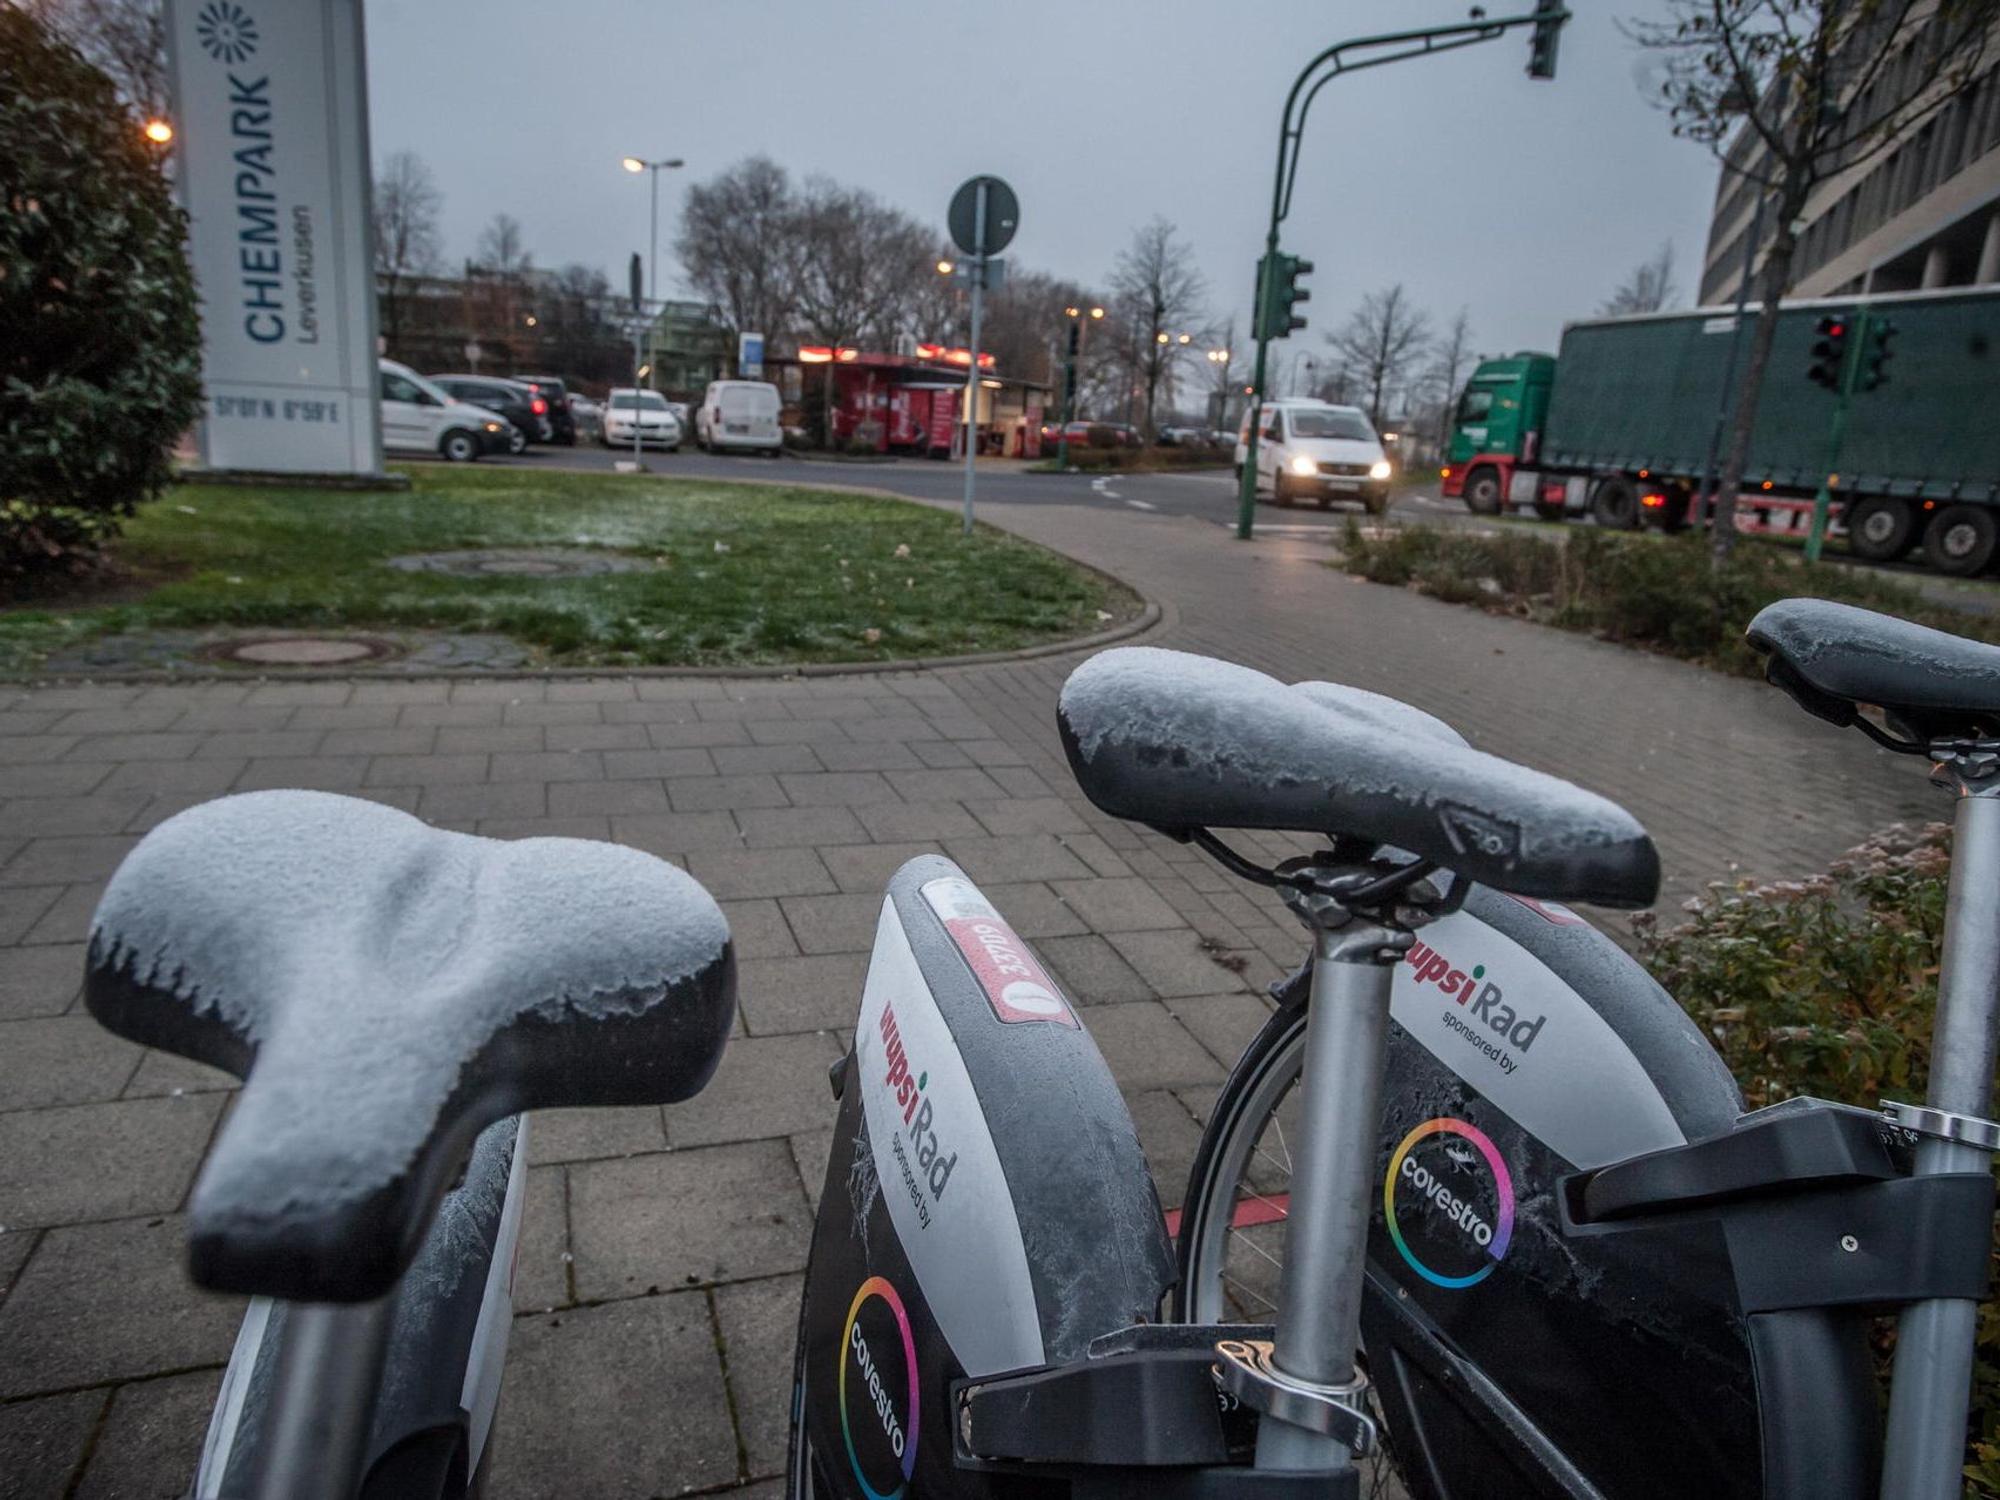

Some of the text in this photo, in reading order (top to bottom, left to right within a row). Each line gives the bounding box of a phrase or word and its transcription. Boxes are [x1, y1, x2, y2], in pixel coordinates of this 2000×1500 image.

[227, 73, 286, 344] CHEMPARK
[292, 204, 318, 345] Leverkusen
[972, 923, 1032, 977] 33709
[1442, 1010, 1518, 1075] sponsored by
[893, 1131, 931, 1230] sponsored by
[1402, 1156, 1492, 1246] covestro
[851, 1321, 904, 1458] covestro
